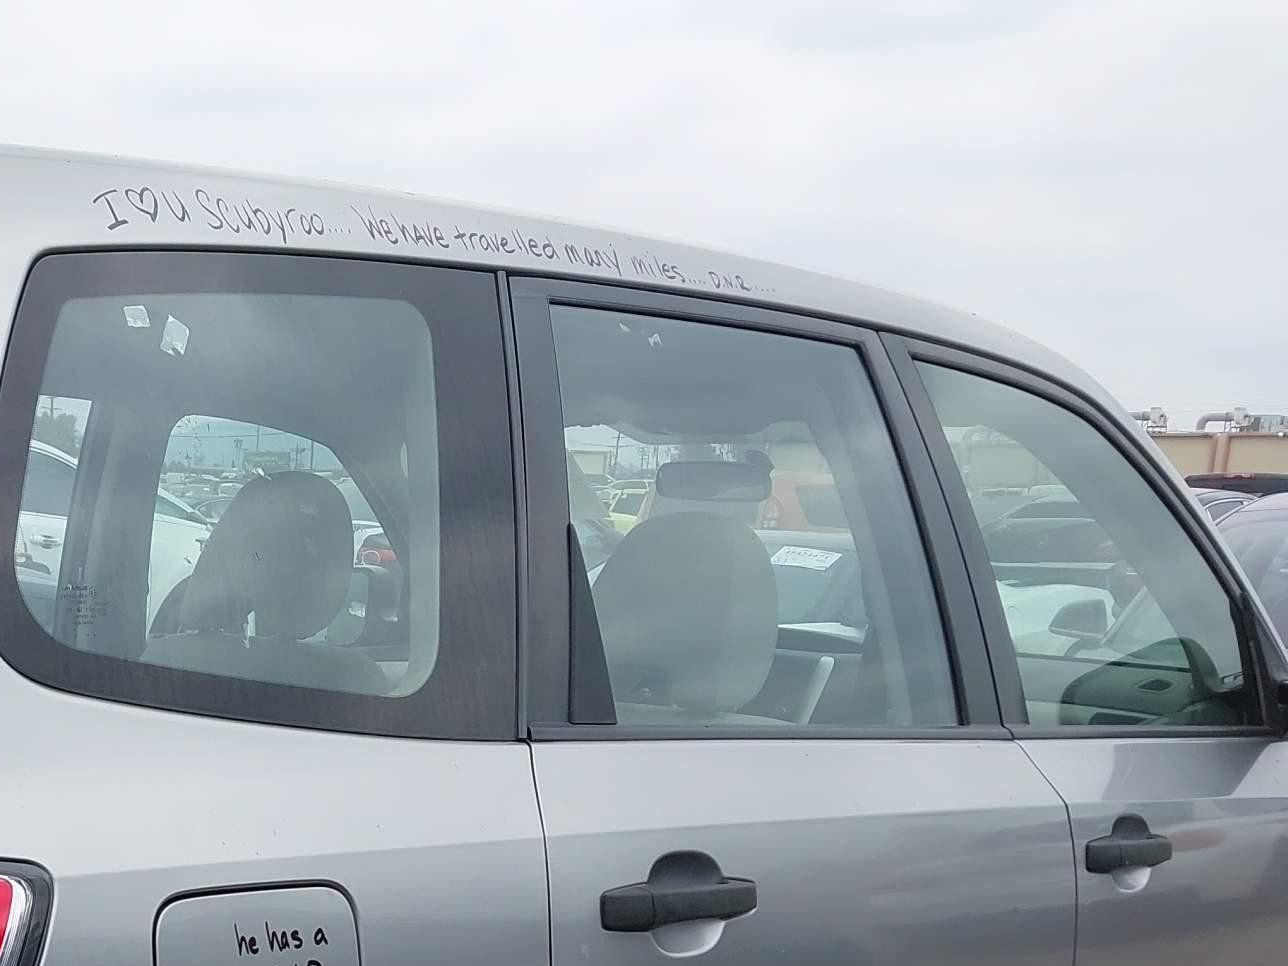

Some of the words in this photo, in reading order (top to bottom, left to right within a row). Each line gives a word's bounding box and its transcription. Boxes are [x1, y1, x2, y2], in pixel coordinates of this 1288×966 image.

[453, 224, 560, 260] travelled
[564, 243, 623, 277] many
[234, 923, 260, 956] he
[265, 921, 303, 952] has
[313, 927, 328, 946] a
